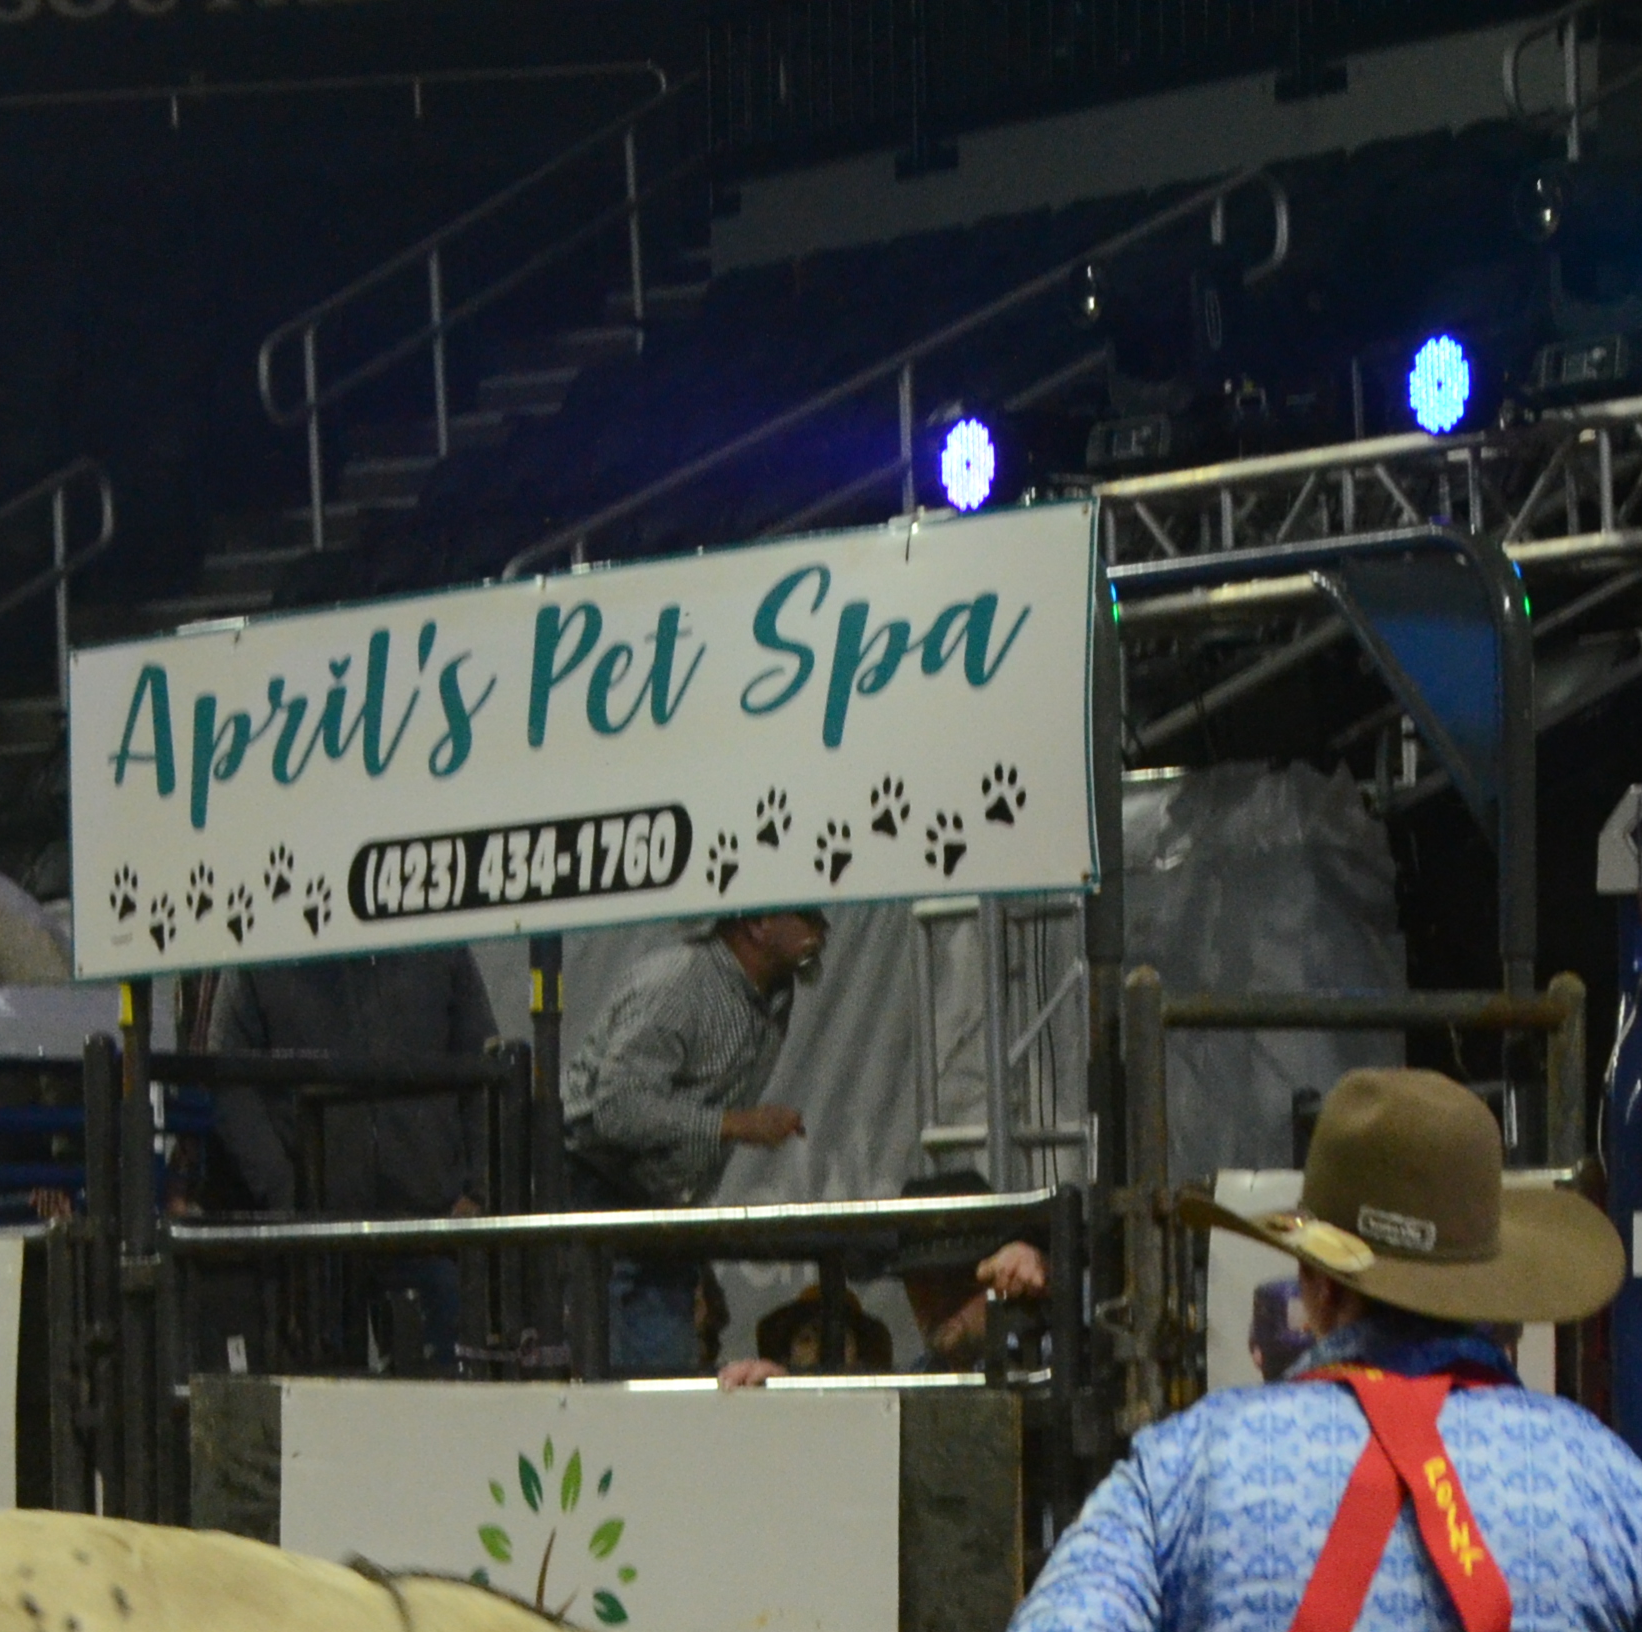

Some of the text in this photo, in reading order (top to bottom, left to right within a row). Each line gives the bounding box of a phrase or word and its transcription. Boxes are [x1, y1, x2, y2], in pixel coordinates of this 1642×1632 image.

[109, 565, 1031, 829] April's Pet Spa
[363, 809, 676, 918] (423) 434-1760
